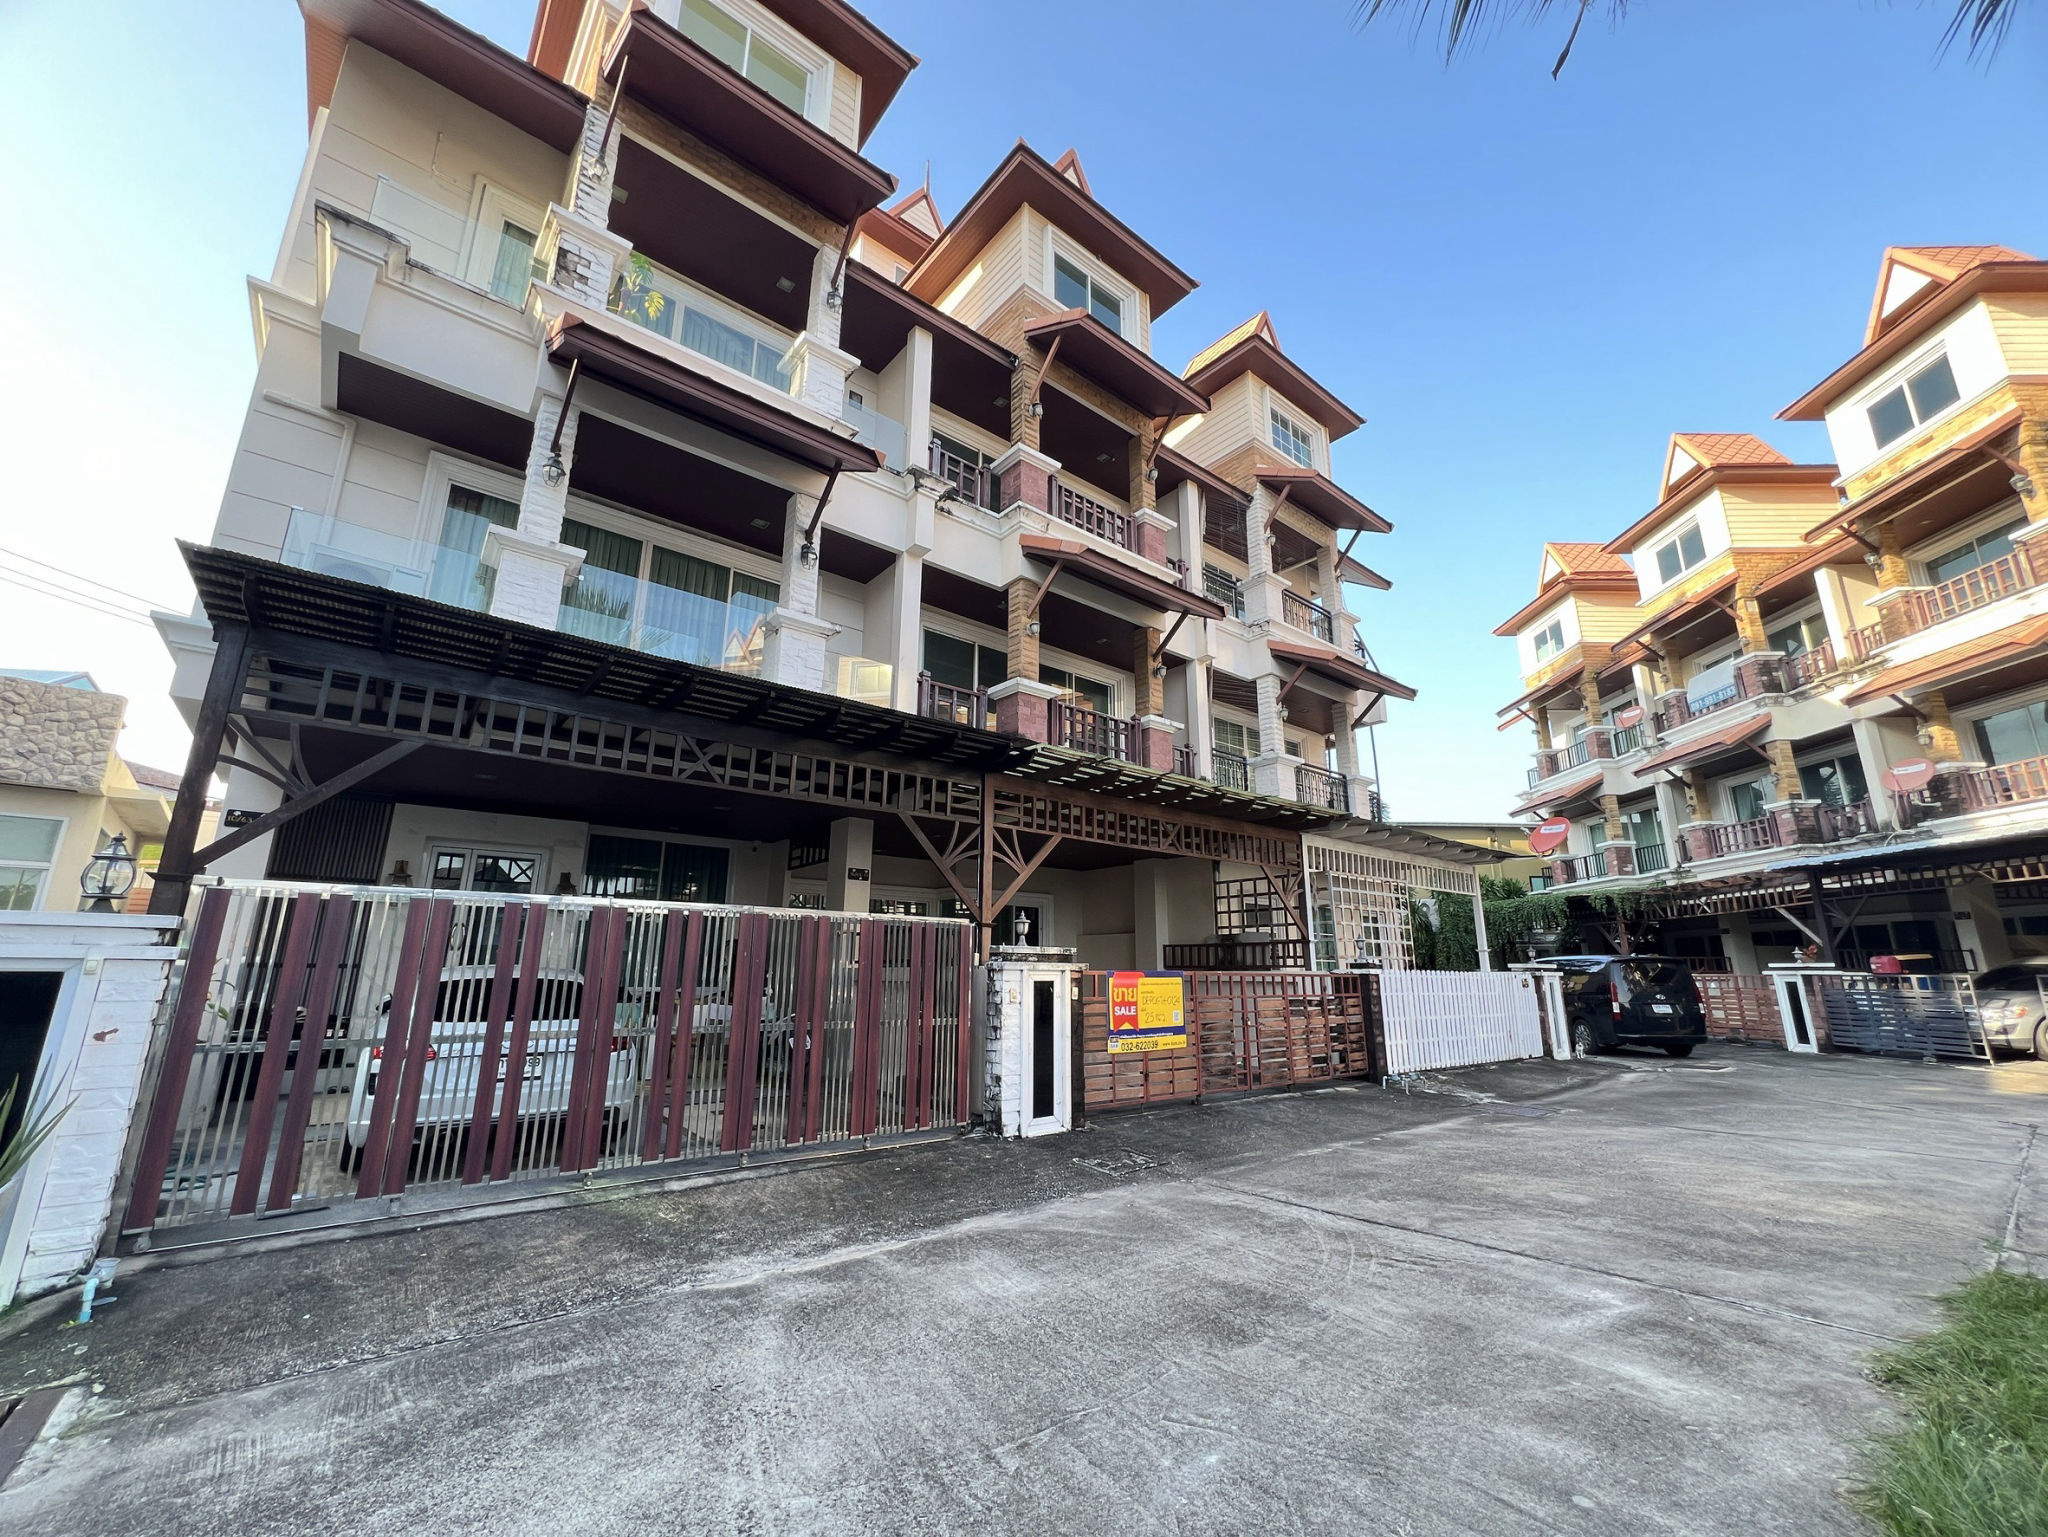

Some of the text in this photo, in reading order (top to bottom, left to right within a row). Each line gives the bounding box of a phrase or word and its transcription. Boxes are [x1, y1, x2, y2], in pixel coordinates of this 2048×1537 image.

[1113, 987, 1137, 1002] ขาย
[1114, 1005, 1137, 1016] SALE
[1121, 1040, 1158, 1052] 032-622039
